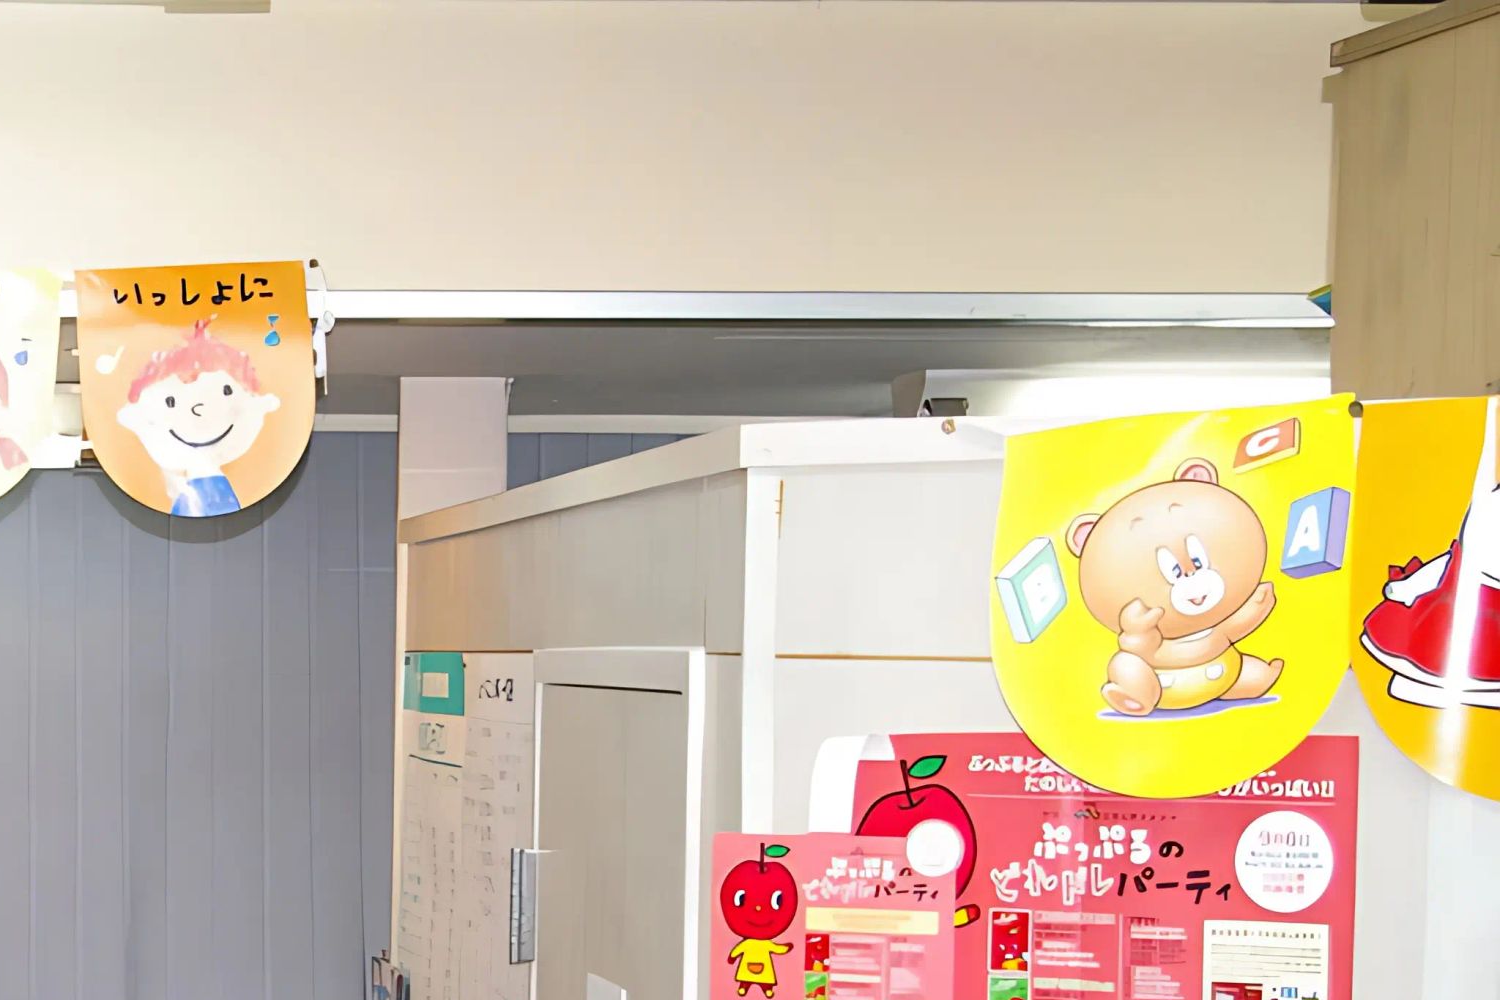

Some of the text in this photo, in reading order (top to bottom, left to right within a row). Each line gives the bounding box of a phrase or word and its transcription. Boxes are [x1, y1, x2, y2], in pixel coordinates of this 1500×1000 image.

[113, 273, 275, 305] いっしょに
[1245, 427, 1281, 457] C
[1287, 504, 1320, 557] A
